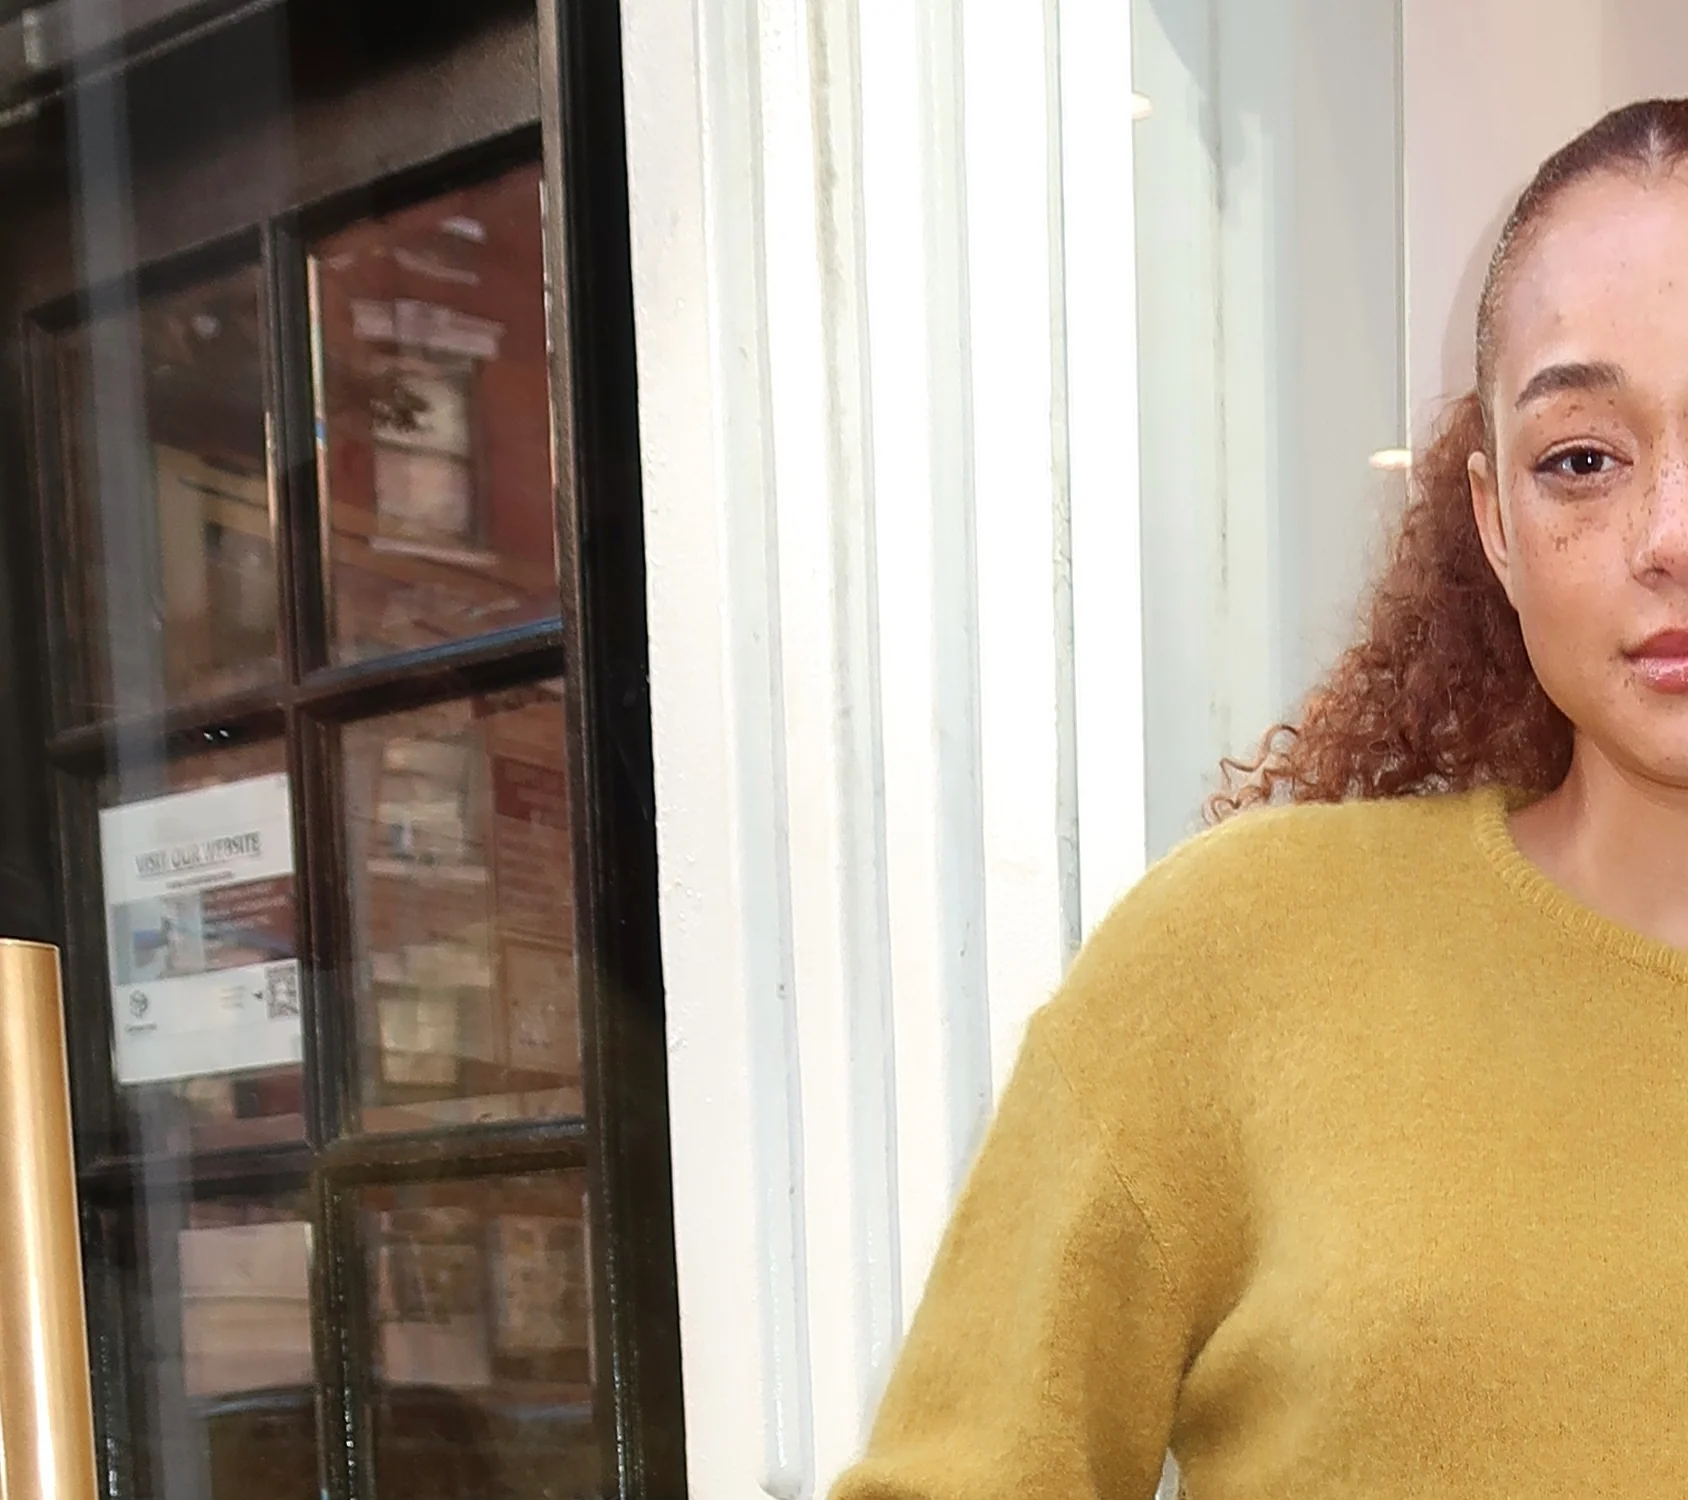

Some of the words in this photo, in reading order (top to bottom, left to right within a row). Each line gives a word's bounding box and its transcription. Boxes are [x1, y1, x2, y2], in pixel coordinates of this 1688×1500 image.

[135, 849, 166, 873] VISIT
[169, 843, 201, 869] OUR
[202, 831, 262, 862] WEBSITE
